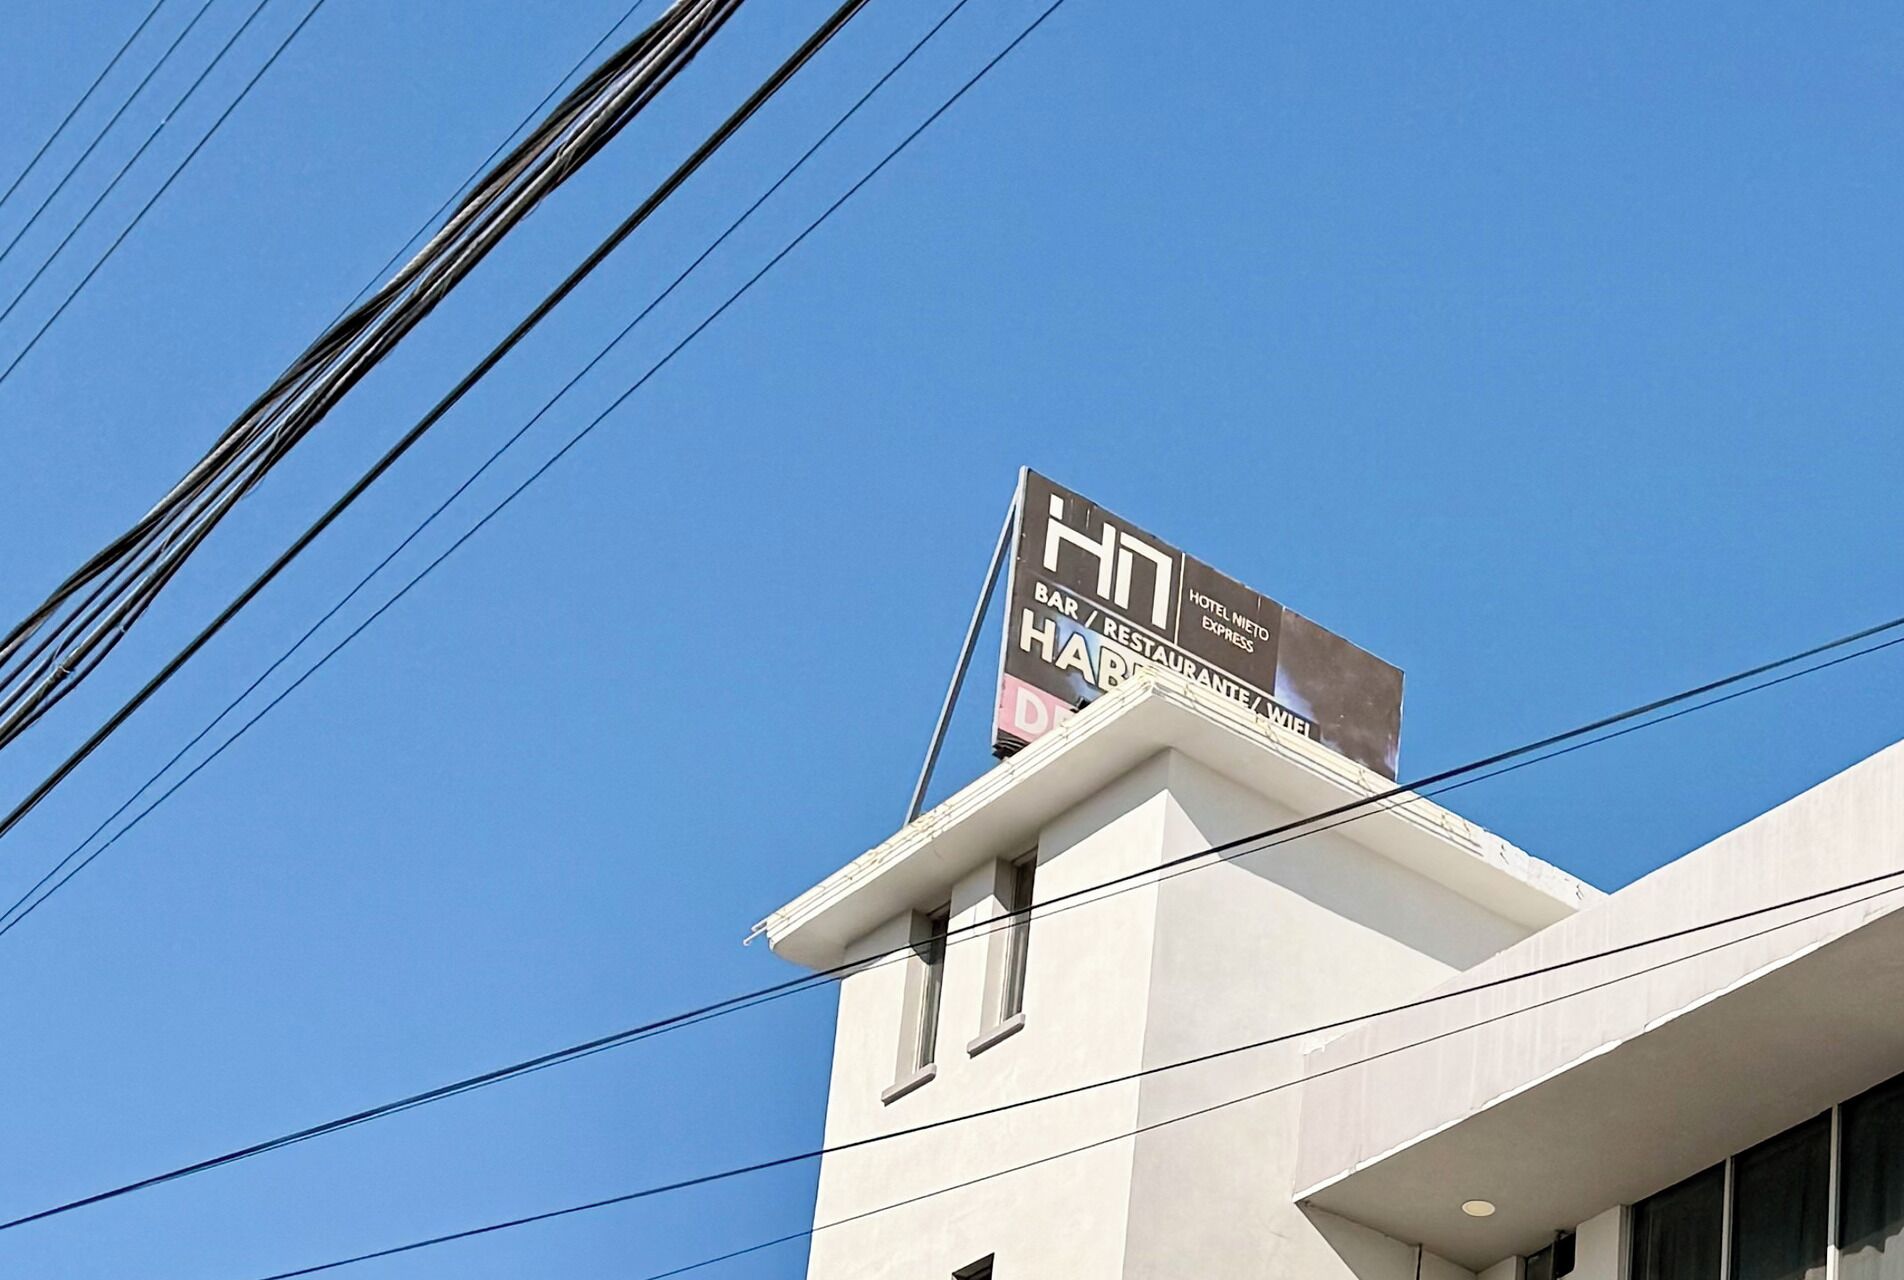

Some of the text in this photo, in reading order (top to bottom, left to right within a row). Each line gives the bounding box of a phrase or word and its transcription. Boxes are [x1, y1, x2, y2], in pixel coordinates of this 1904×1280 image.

[1034, 582, 1079, 619] BAR
[1189, 589, 1270, 642] HOTEL NIETO
[1202, 616, 1254, 653] EXPRESS
